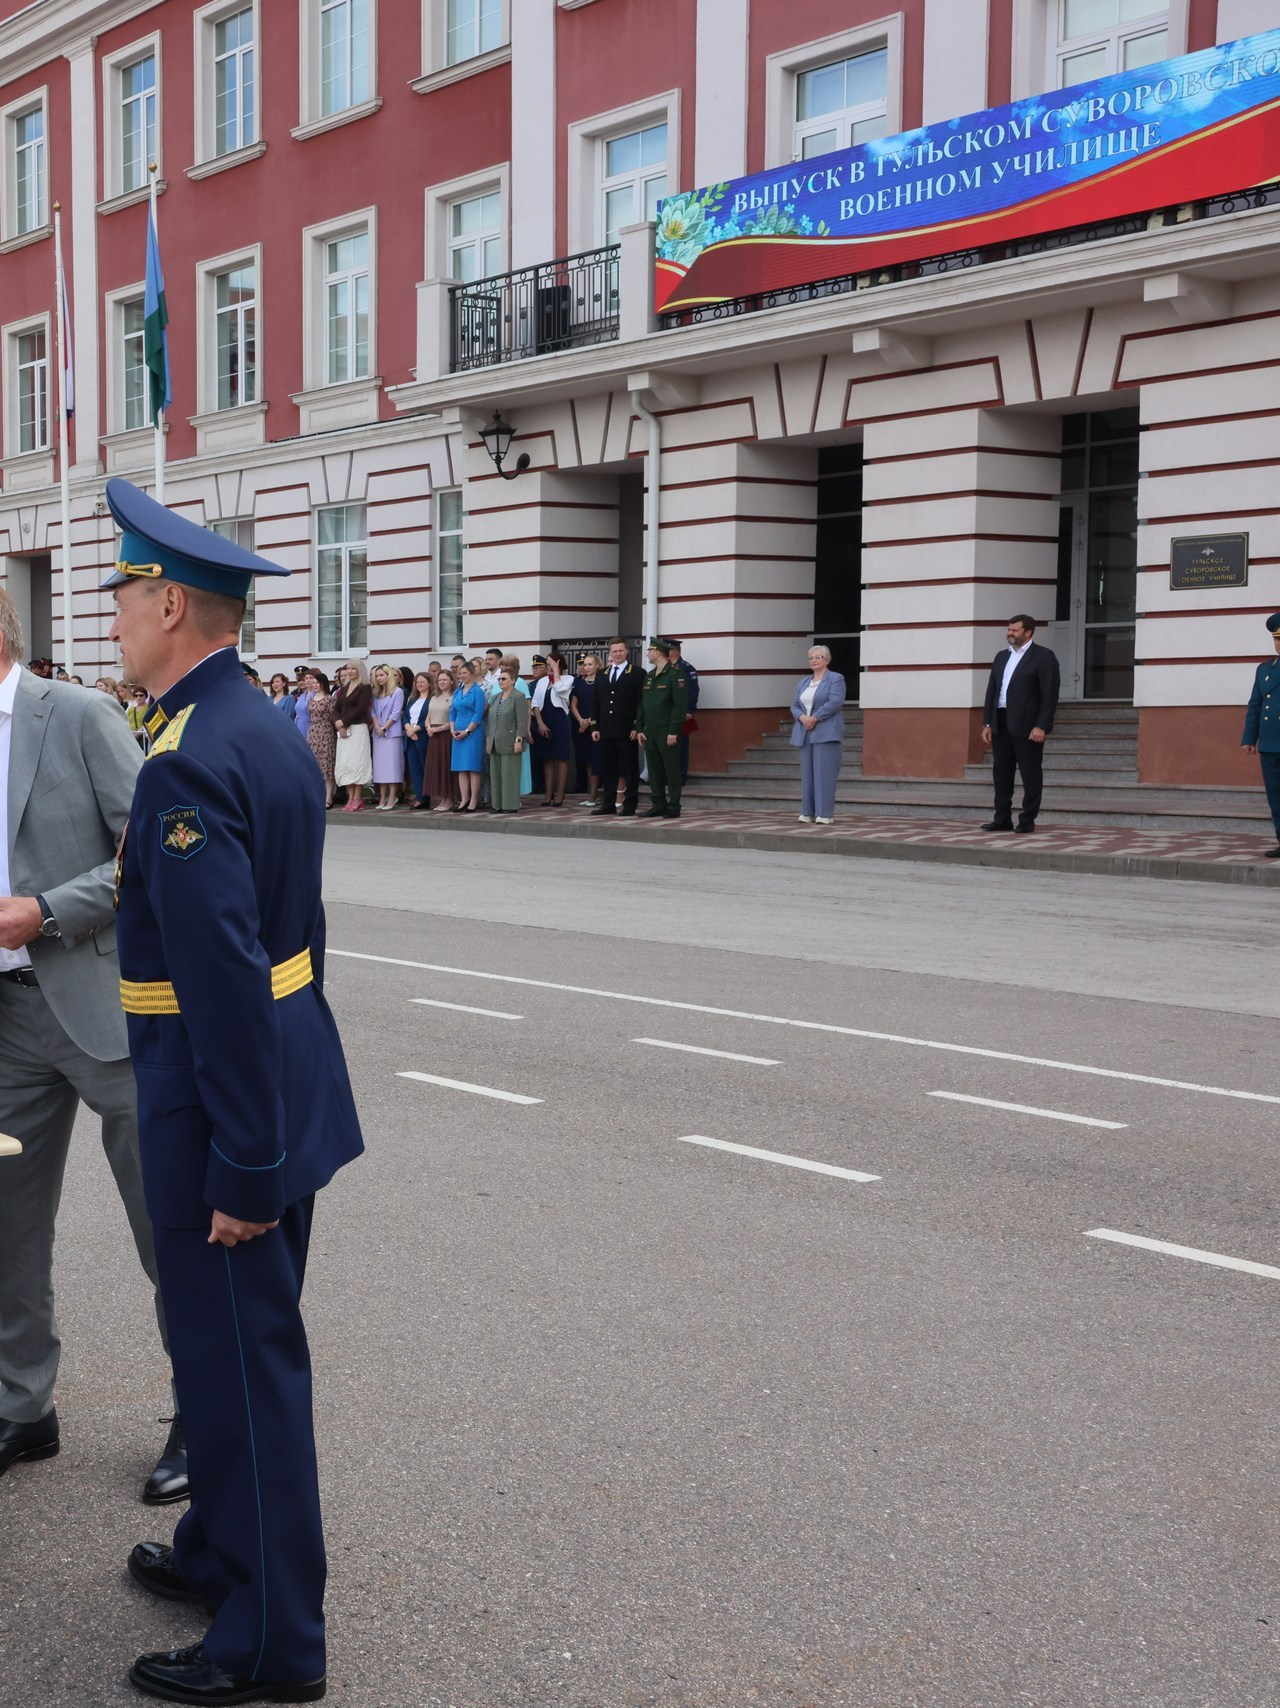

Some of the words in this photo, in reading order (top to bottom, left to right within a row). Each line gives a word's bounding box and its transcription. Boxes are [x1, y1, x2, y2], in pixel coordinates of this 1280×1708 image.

[734, 166, 843, 214] ВЫПУСК
[850, 161, 866, 184] В
[872, 114, 1034, 177] ТУЛЬСКОМ
[839, 165, 983, 221] ВОЕННОМ
[991, 121, 1162, 184] УЧИЛИЩЕ
[163, 810, 196, 822] РОССИЯ
